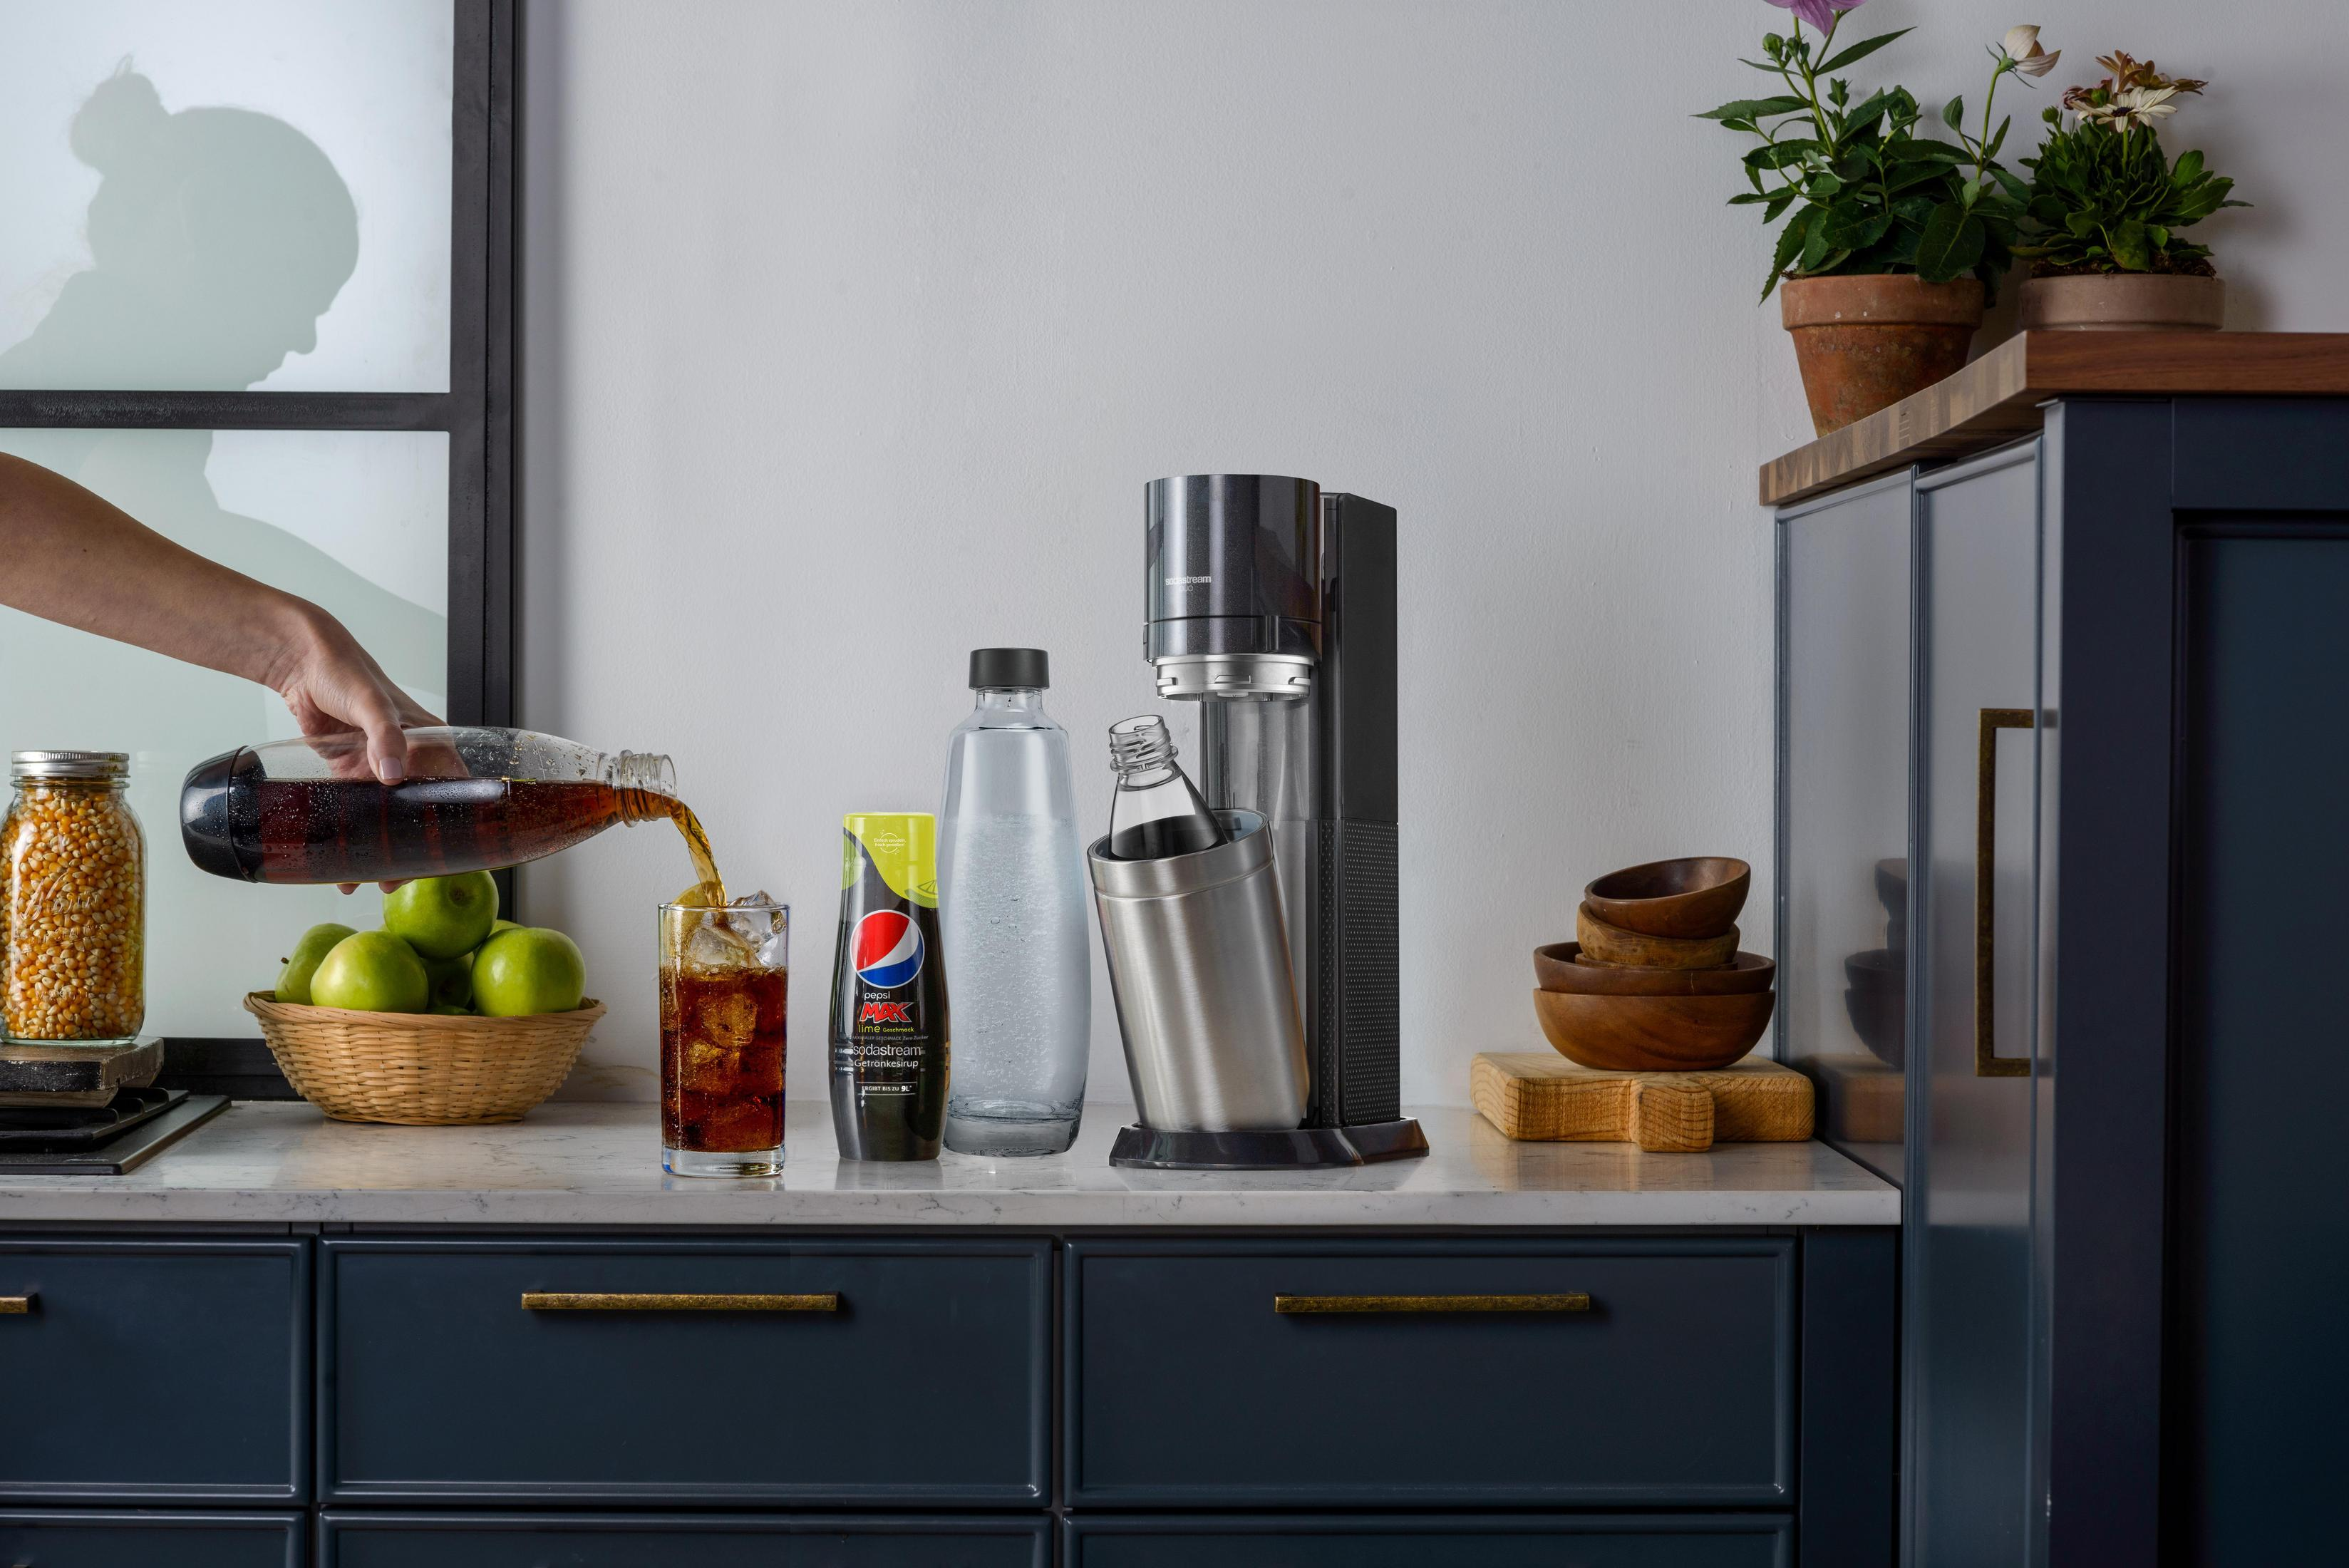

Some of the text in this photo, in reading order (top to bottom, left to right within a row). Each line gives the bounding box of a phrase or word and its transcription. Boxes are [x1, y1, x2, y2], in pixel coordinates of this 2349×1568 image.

[864, 991, 890, 1001] pepsi
[859, 1002, 914, 1023] MAX
[858, 1025, 881, 1033] lime
[853, 1043, 921, 1056] sodastream
[854, 1059, 919, 1069] Getränkesirup
